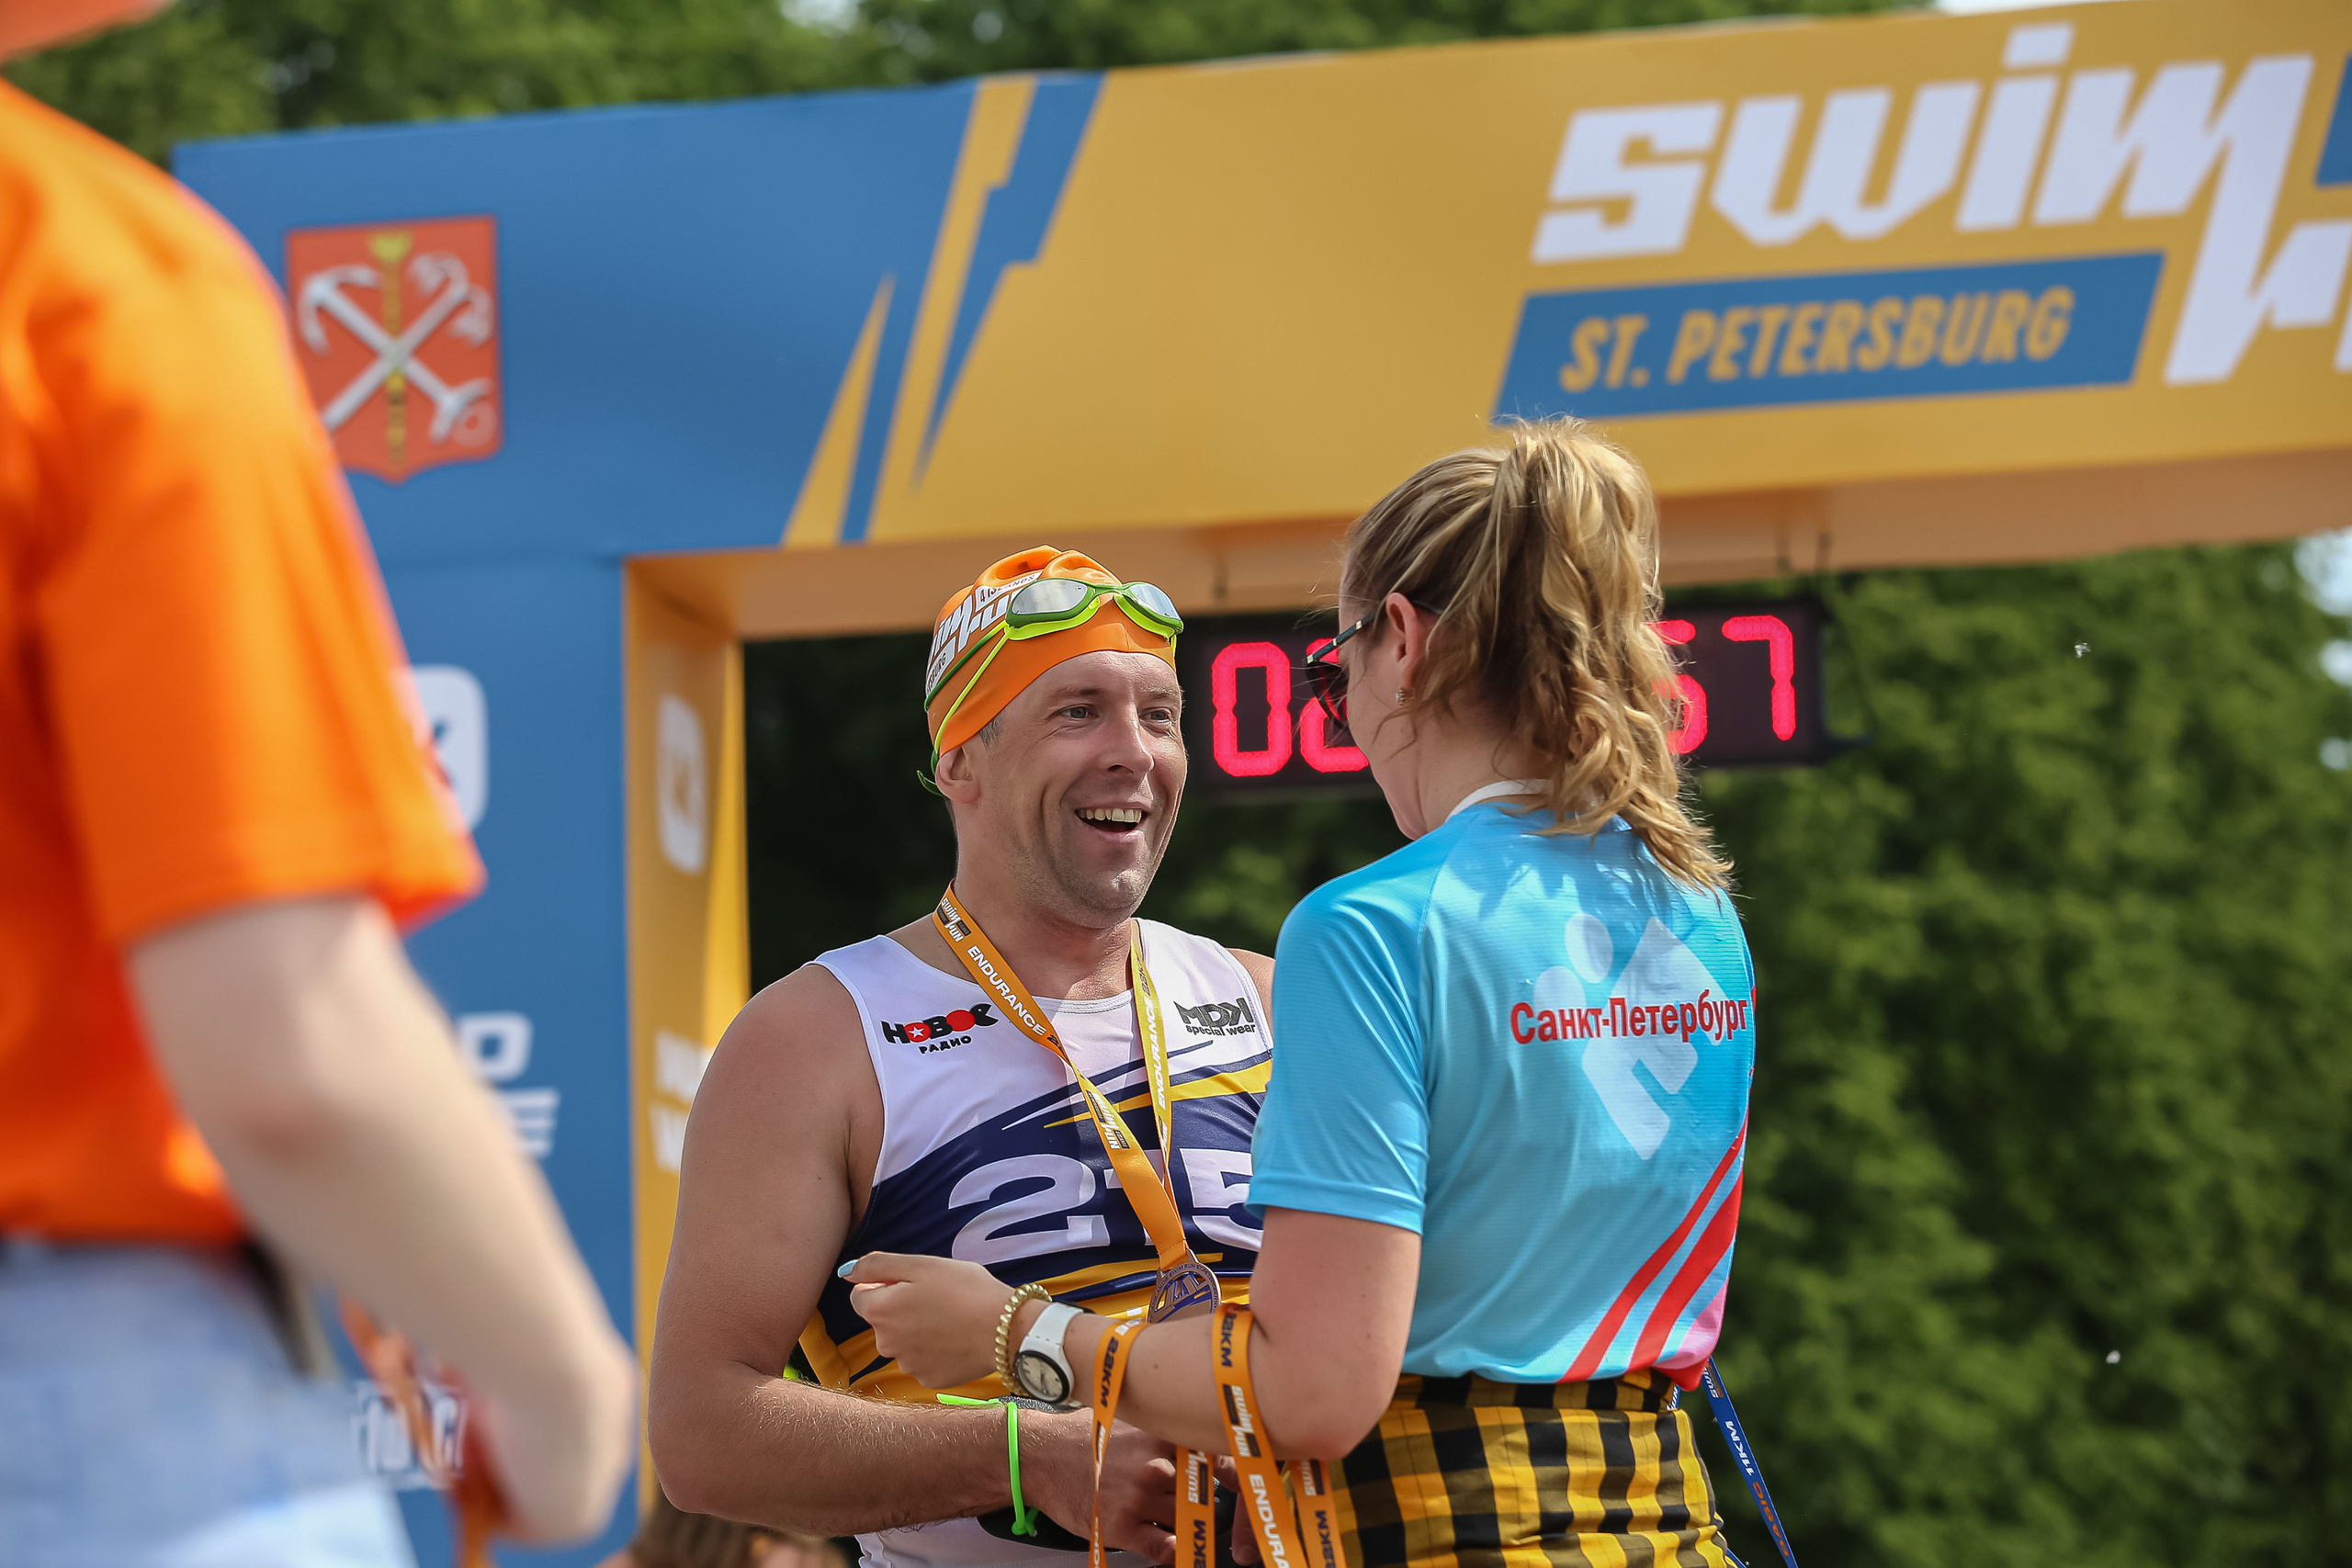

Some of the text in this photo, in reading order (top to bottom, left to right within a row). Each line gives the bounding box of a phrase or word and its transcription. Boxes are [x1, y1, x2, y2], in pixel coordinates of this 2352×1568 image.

[1560, 313, 1649, 393] ST.
[1667, 285, 2076, 386] PETERSBURG
[967, 945, 1046, 1037] ENDURANCE
[1186, 1024, 1256, 1037] special wear
[1510, 989, 1747, 1044] Санкт-Петербург
[1144, 995, 1166, 1111] ENDURANCE
[1725, 1420, 1790, 1557] BASIC 11KM
